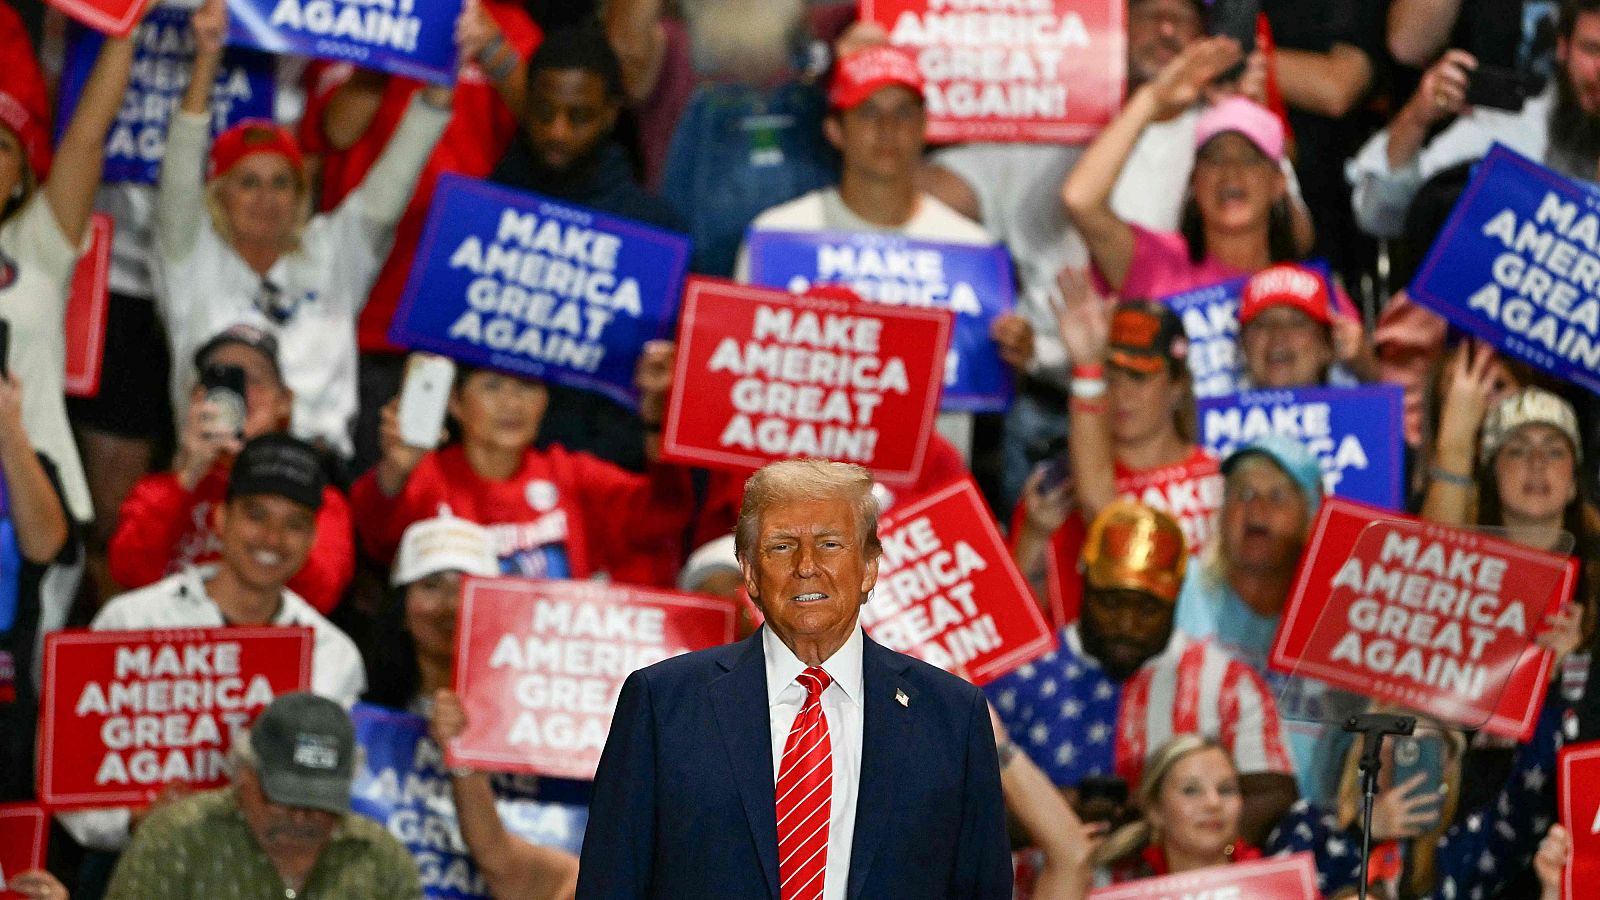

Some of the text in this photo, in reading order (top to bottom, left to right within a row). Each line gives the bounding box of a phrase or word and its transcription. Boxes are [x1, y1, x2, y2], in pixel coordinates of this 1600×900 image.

[270, 0, 421, 52] AGAIN!
[889, 10, 1090, 48] AMERICA
[917, 48, 1064, 81] GREAT
[497, 207, 622, 271] MAKE
[1535, 190, 1600, 252] MA
[449, 235, 643, 318] AMERICA
[816, 244, 945, 280] MAKE
[1481, 208, 1600, 294] AMER
[465, 277, 615, 342] GREAT
[1492, 252, 1600, 337] GREA
[448, 310, 606, 373] AGAIN!
[753, 304, 884, 353] MAKE
[1467, 282, 1600, 370] AGAIN
[707, 336, 910, 395] AMERICA
[730, 378, 884, 426] GREAT
[1203, 403, 1332, 443] MAKE
[720, 414, 879, 464] AGAIN!
[1122, 476, 1225, 515] AKE
[878, 516, 942, 576] KE
[1380, 530, 1508, 592] MAKE
[860, 539, 988, 628] ERICA
[1331, 557, 1527, 636] AMERICA
[532, 599, 667, 644] MAKE
[870, 580, 978, 652] REAT
[920, 614, 1003, 670] AIN!
[1348, 599, 1497, 660] GREAT
[113, 642, 242, 679] MAKE
[488, 632, 693, 678] AMERI
[1330, 632, 1488, 699] AGAIN!
[75, 674, 275, 717] AMERICA
[512, 674, 616, 714] GRE
[101, 712, 250, 749] GREAT
[507, 710, 607, 750] AGA
[95, 750, 231, 786] AGAIN
